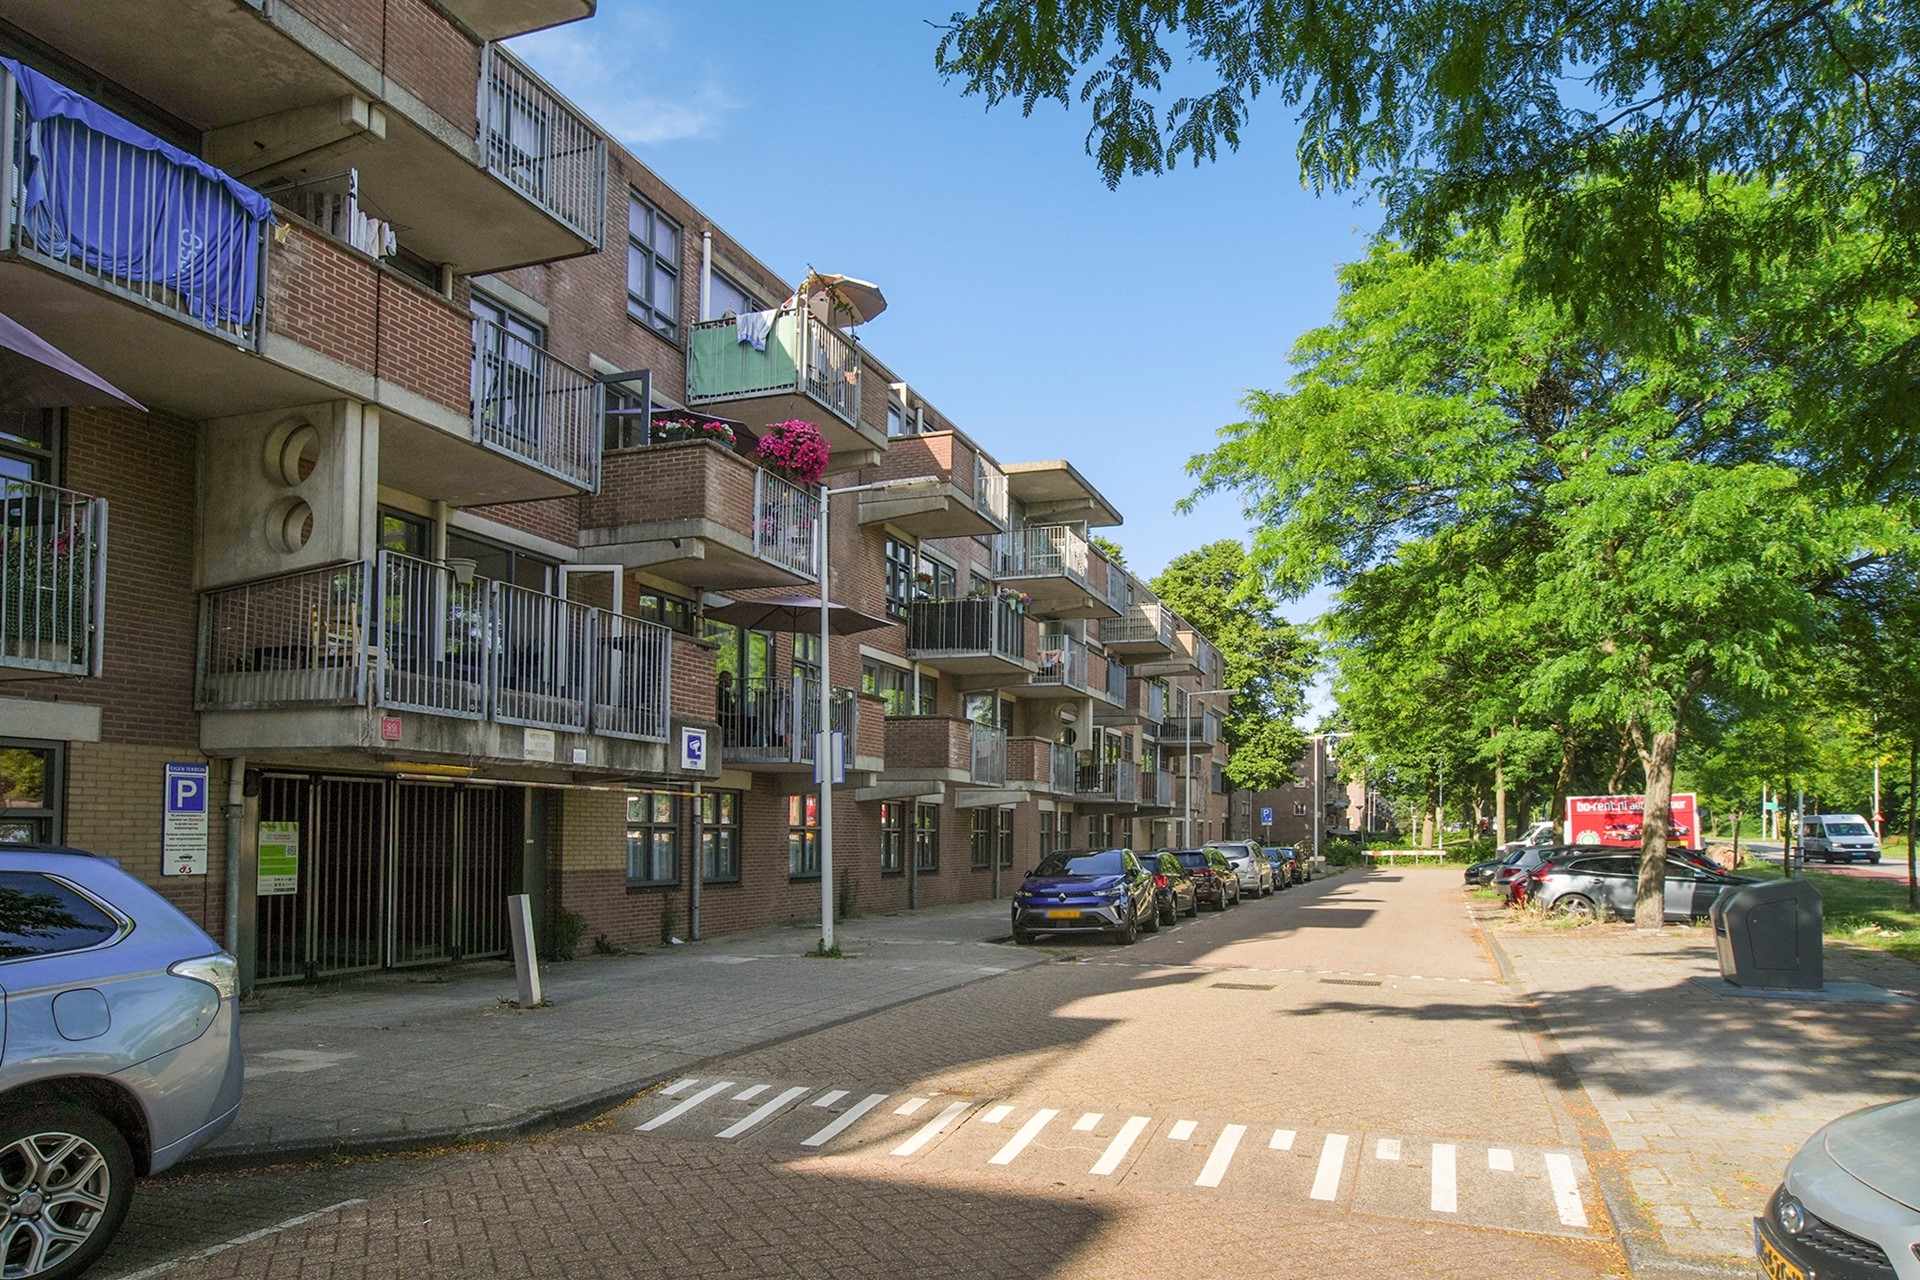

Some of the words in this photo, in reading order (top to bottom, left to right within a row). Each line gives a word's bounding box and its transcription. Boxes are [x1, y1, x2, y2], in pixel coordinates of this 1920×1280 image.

[177, 779, 198, 808] P
[1577, 800, 1627, 812] bo-rent.nl
[1263, 809, 1269, 817] P
